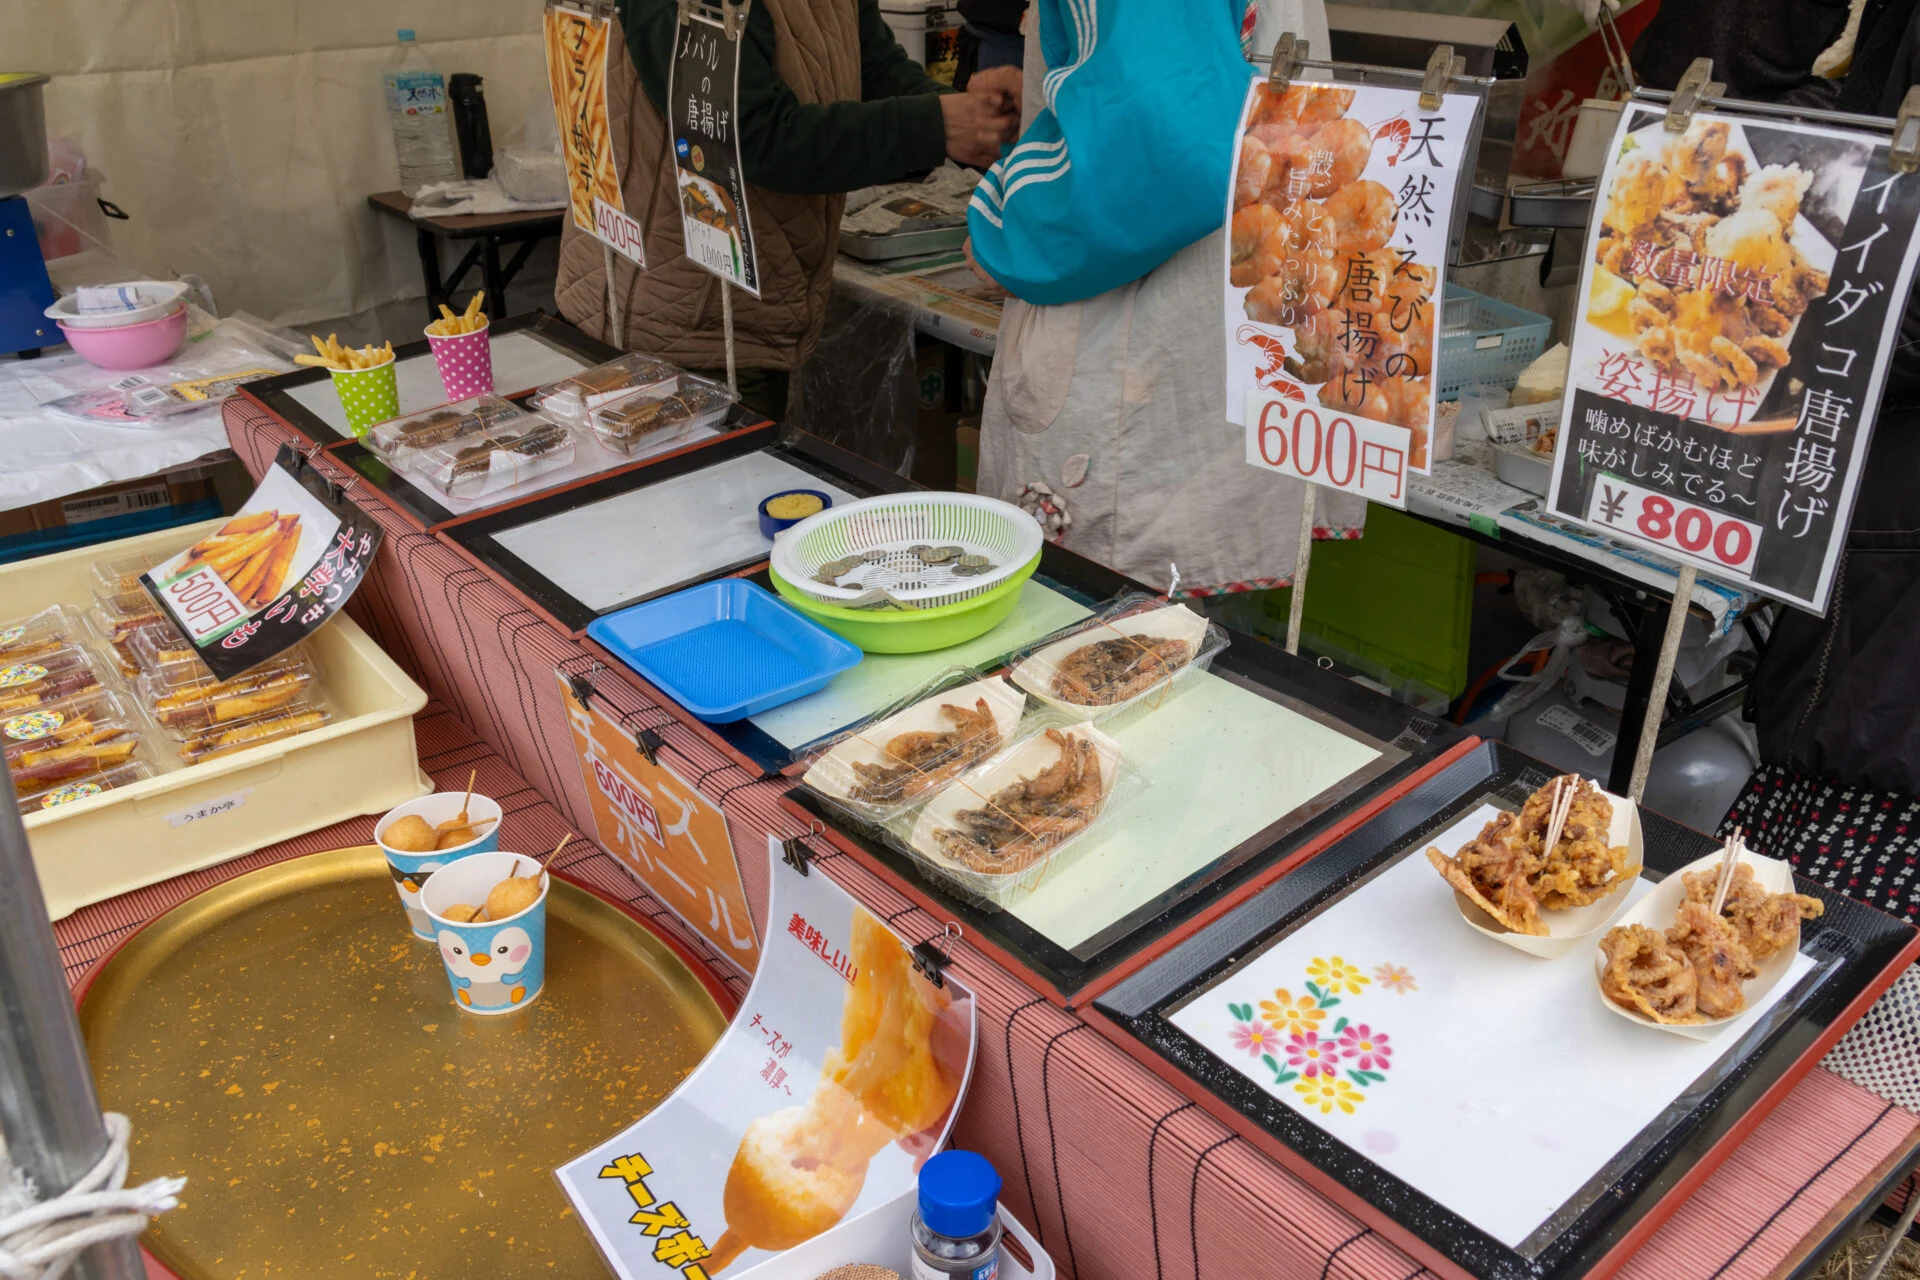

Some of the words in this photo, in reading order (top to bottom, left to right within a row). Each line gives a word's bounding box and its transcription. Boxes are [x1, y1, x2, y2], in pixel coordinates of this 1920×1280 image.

[679, 31, 720, 72] メバル
[701, 76, 711, 95] の
[687, 93, 729, 144] 唐揚げ
[599, 203, 644, 265] 400円
[700, 243, 733, 276] 1000円
[1278, 167, 1308, 326] 旨みたっぷり
[1300, 150, 1335, 337] 殻ごとバリバリ
[1385, 117, 1446, 383] 天然えびの
[1626, 238, 1782, 306] 数量限定
[1327, 252, 1381, 409] 唐揚げ
[1776, 170, 1905, 538] イイダコ唐揚げ
[1595, 347, 1762, 433] 姿揚げ
[1257, 400, 1404, 499] 600円
[1585, 407, 1762, 479] 噛めばかむほど
[170, 571, 241, 635] 500円
[221, 526, 355, 649] 大学いも
[301, 532, 372, 625] やみつき
[570, 707, 708, 865] チーズ
[594, 759, 662, 841] 600円
[786, 912, 859, 983] 美味しいい
[749, 1012, 793, 1059] チーズが
